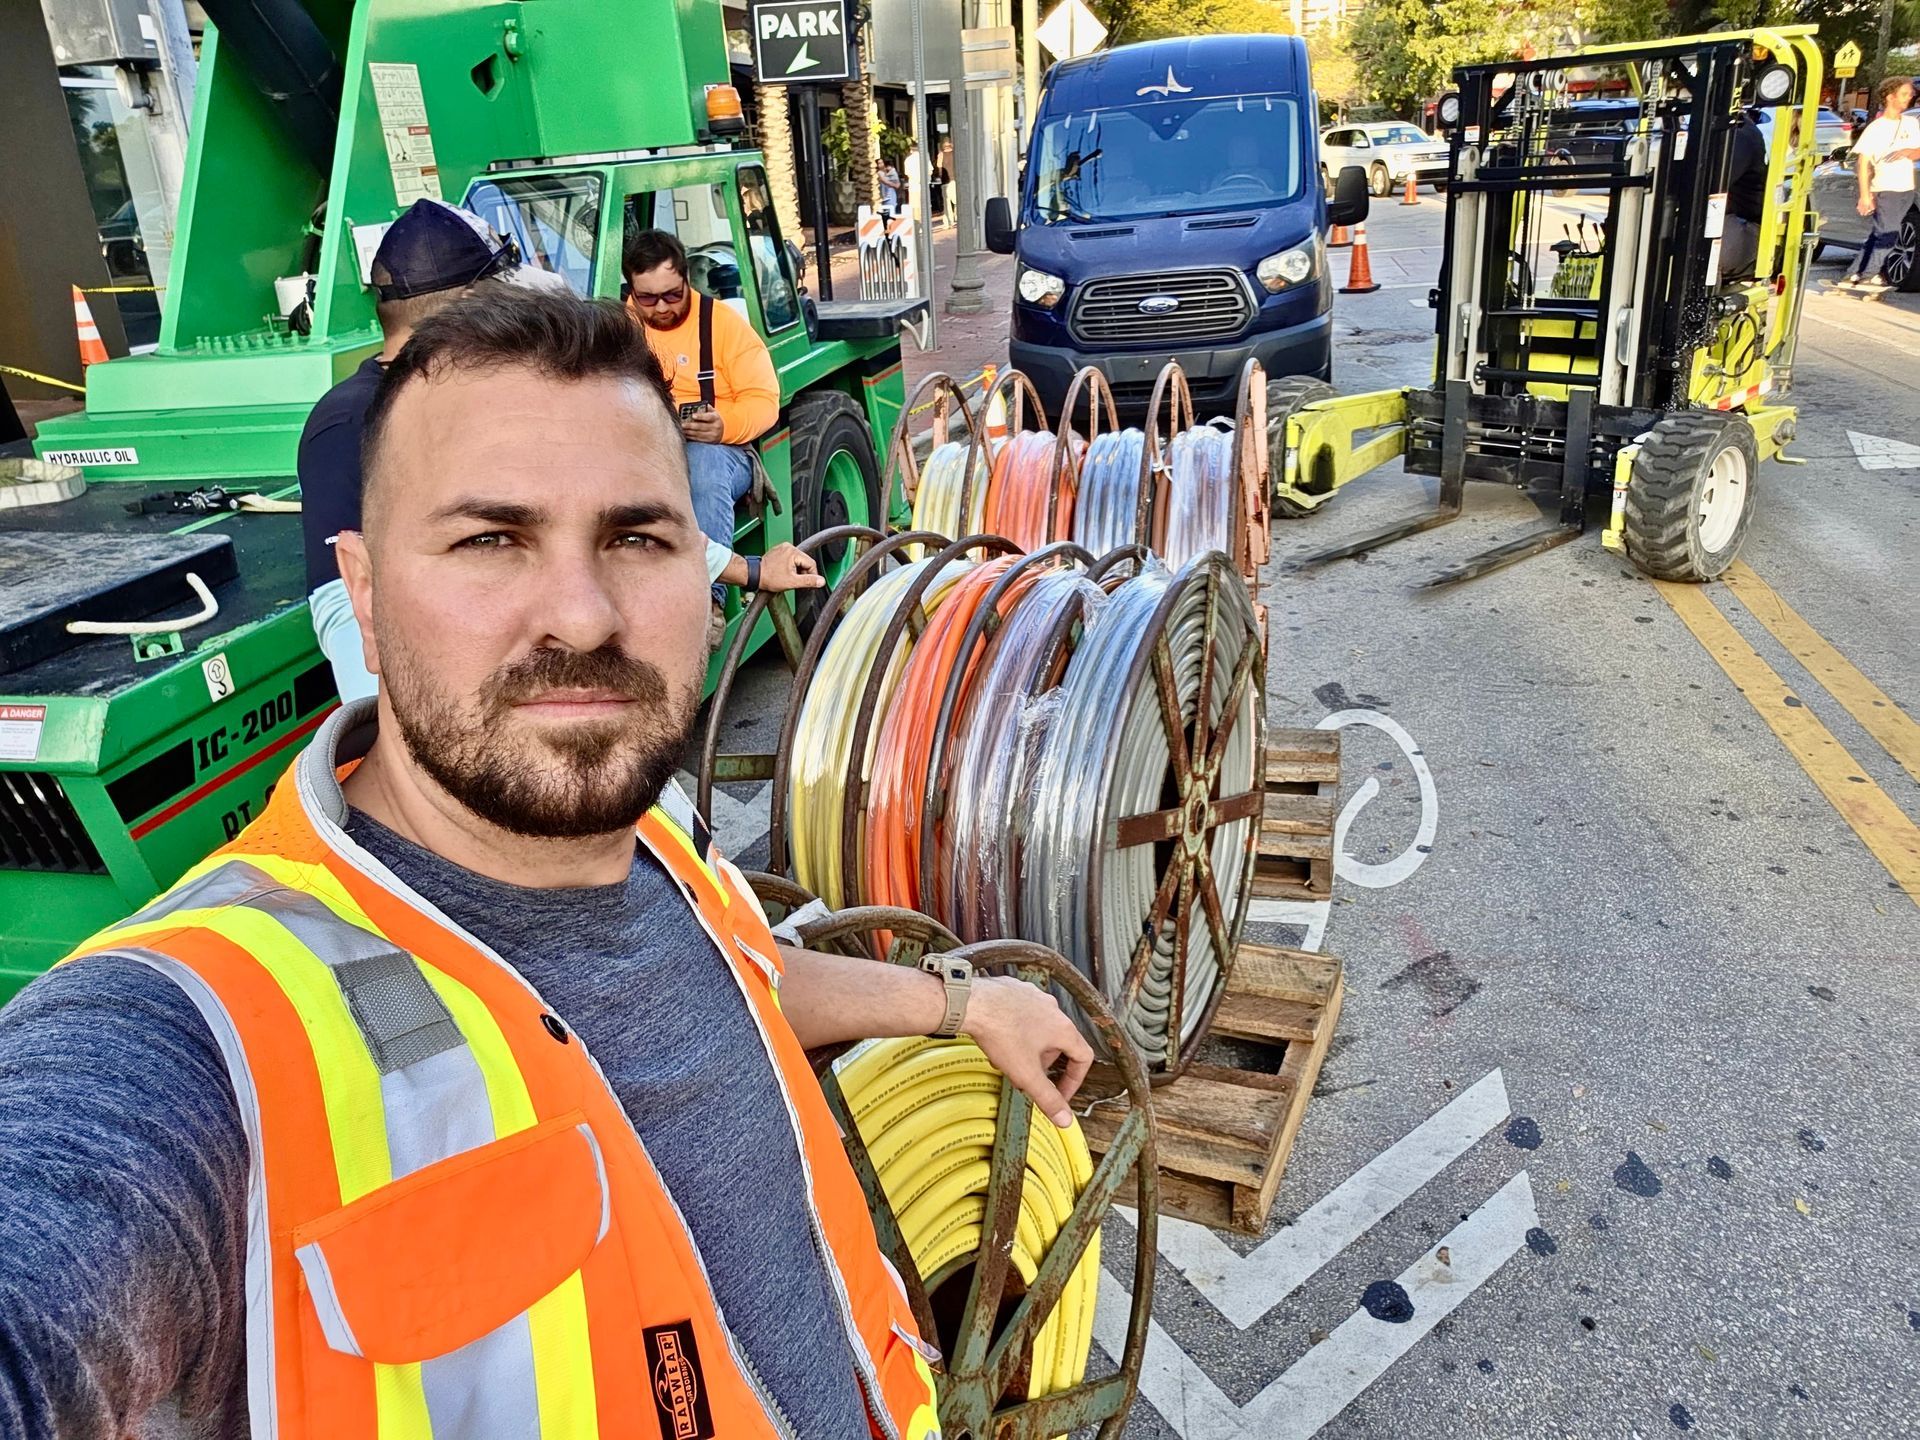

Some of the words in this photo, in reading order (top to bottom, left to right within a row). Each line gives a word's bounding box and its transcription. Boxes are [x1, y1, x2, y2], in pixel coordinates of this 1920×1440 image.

[760, 9, 841, 40] PARK
[48, 451, 112, 465] HYDRAULIC
[114, 450, 132, 462] OIL
[10, 708, 43, 718] DANGER
[197, 690, 294, 771] IC-200
